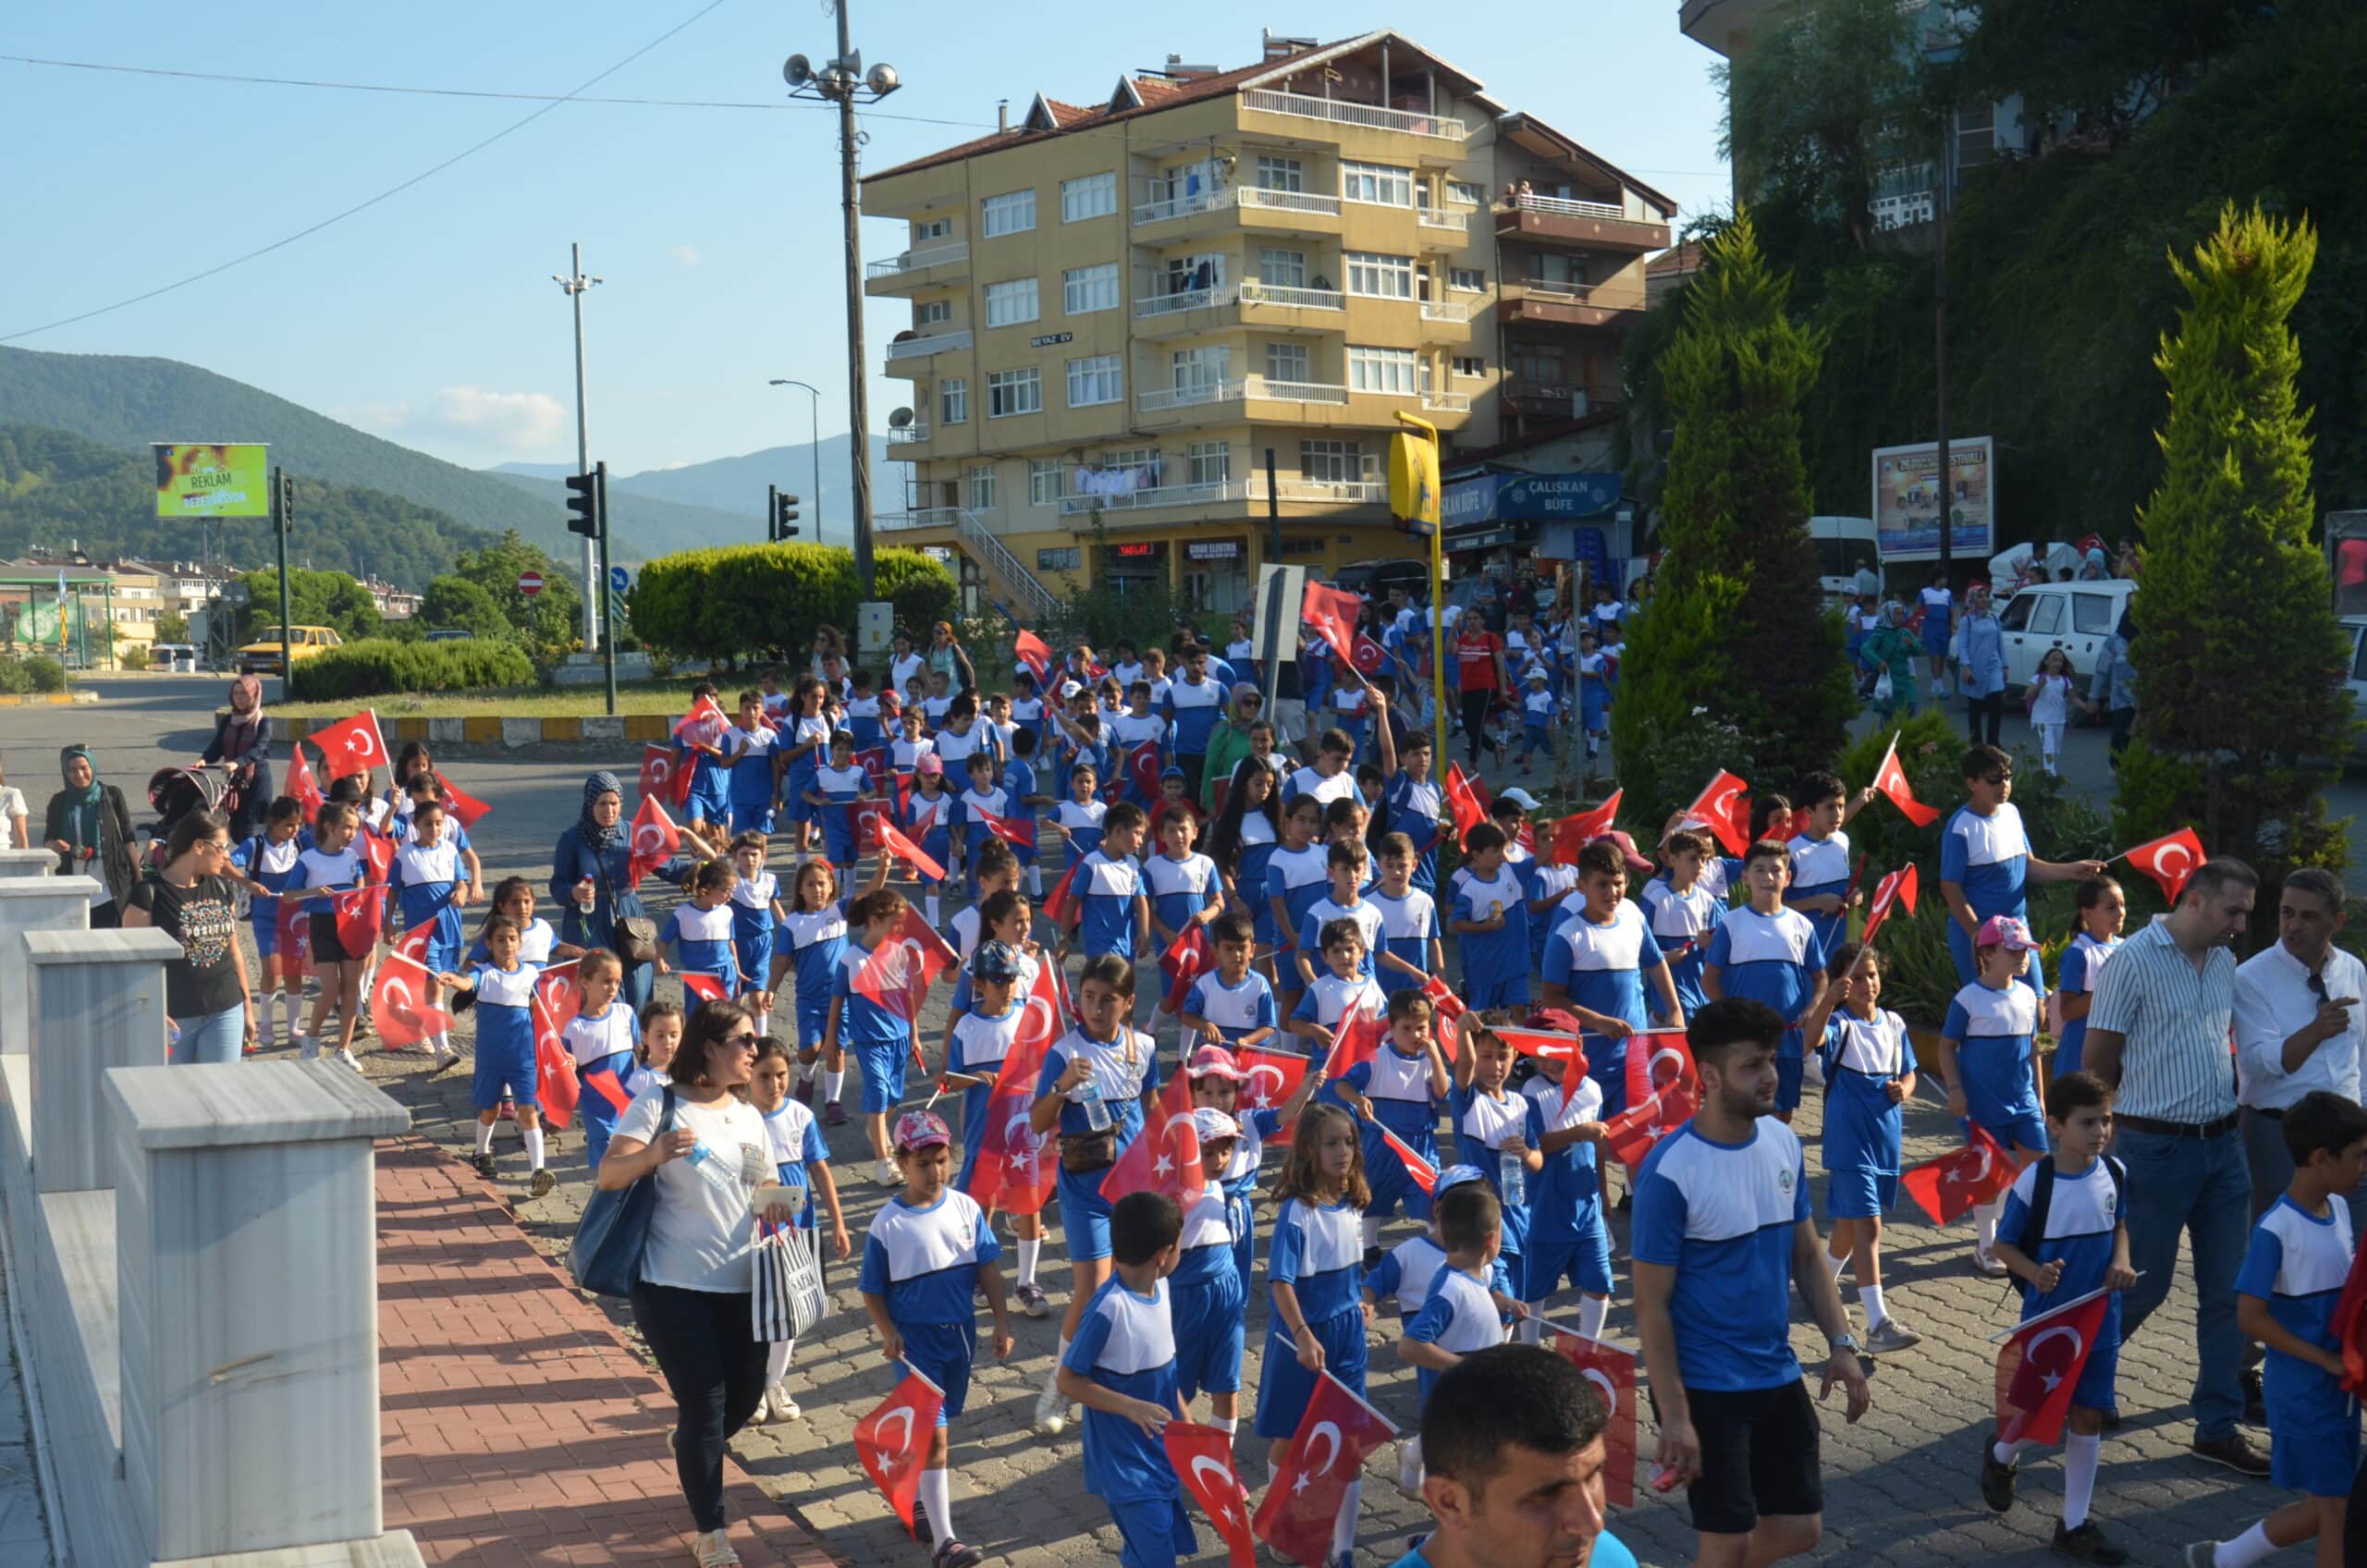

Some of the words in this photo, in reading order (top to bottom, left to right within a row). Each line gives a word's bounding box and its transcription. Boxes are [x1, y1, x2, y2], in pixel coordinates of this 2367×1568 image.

[190, 472, 232, 489] REKLAM
[1528, 481, 1588, 495] ÇALIŞKAN
[1544, 497, 1576, 511] BÜFE
